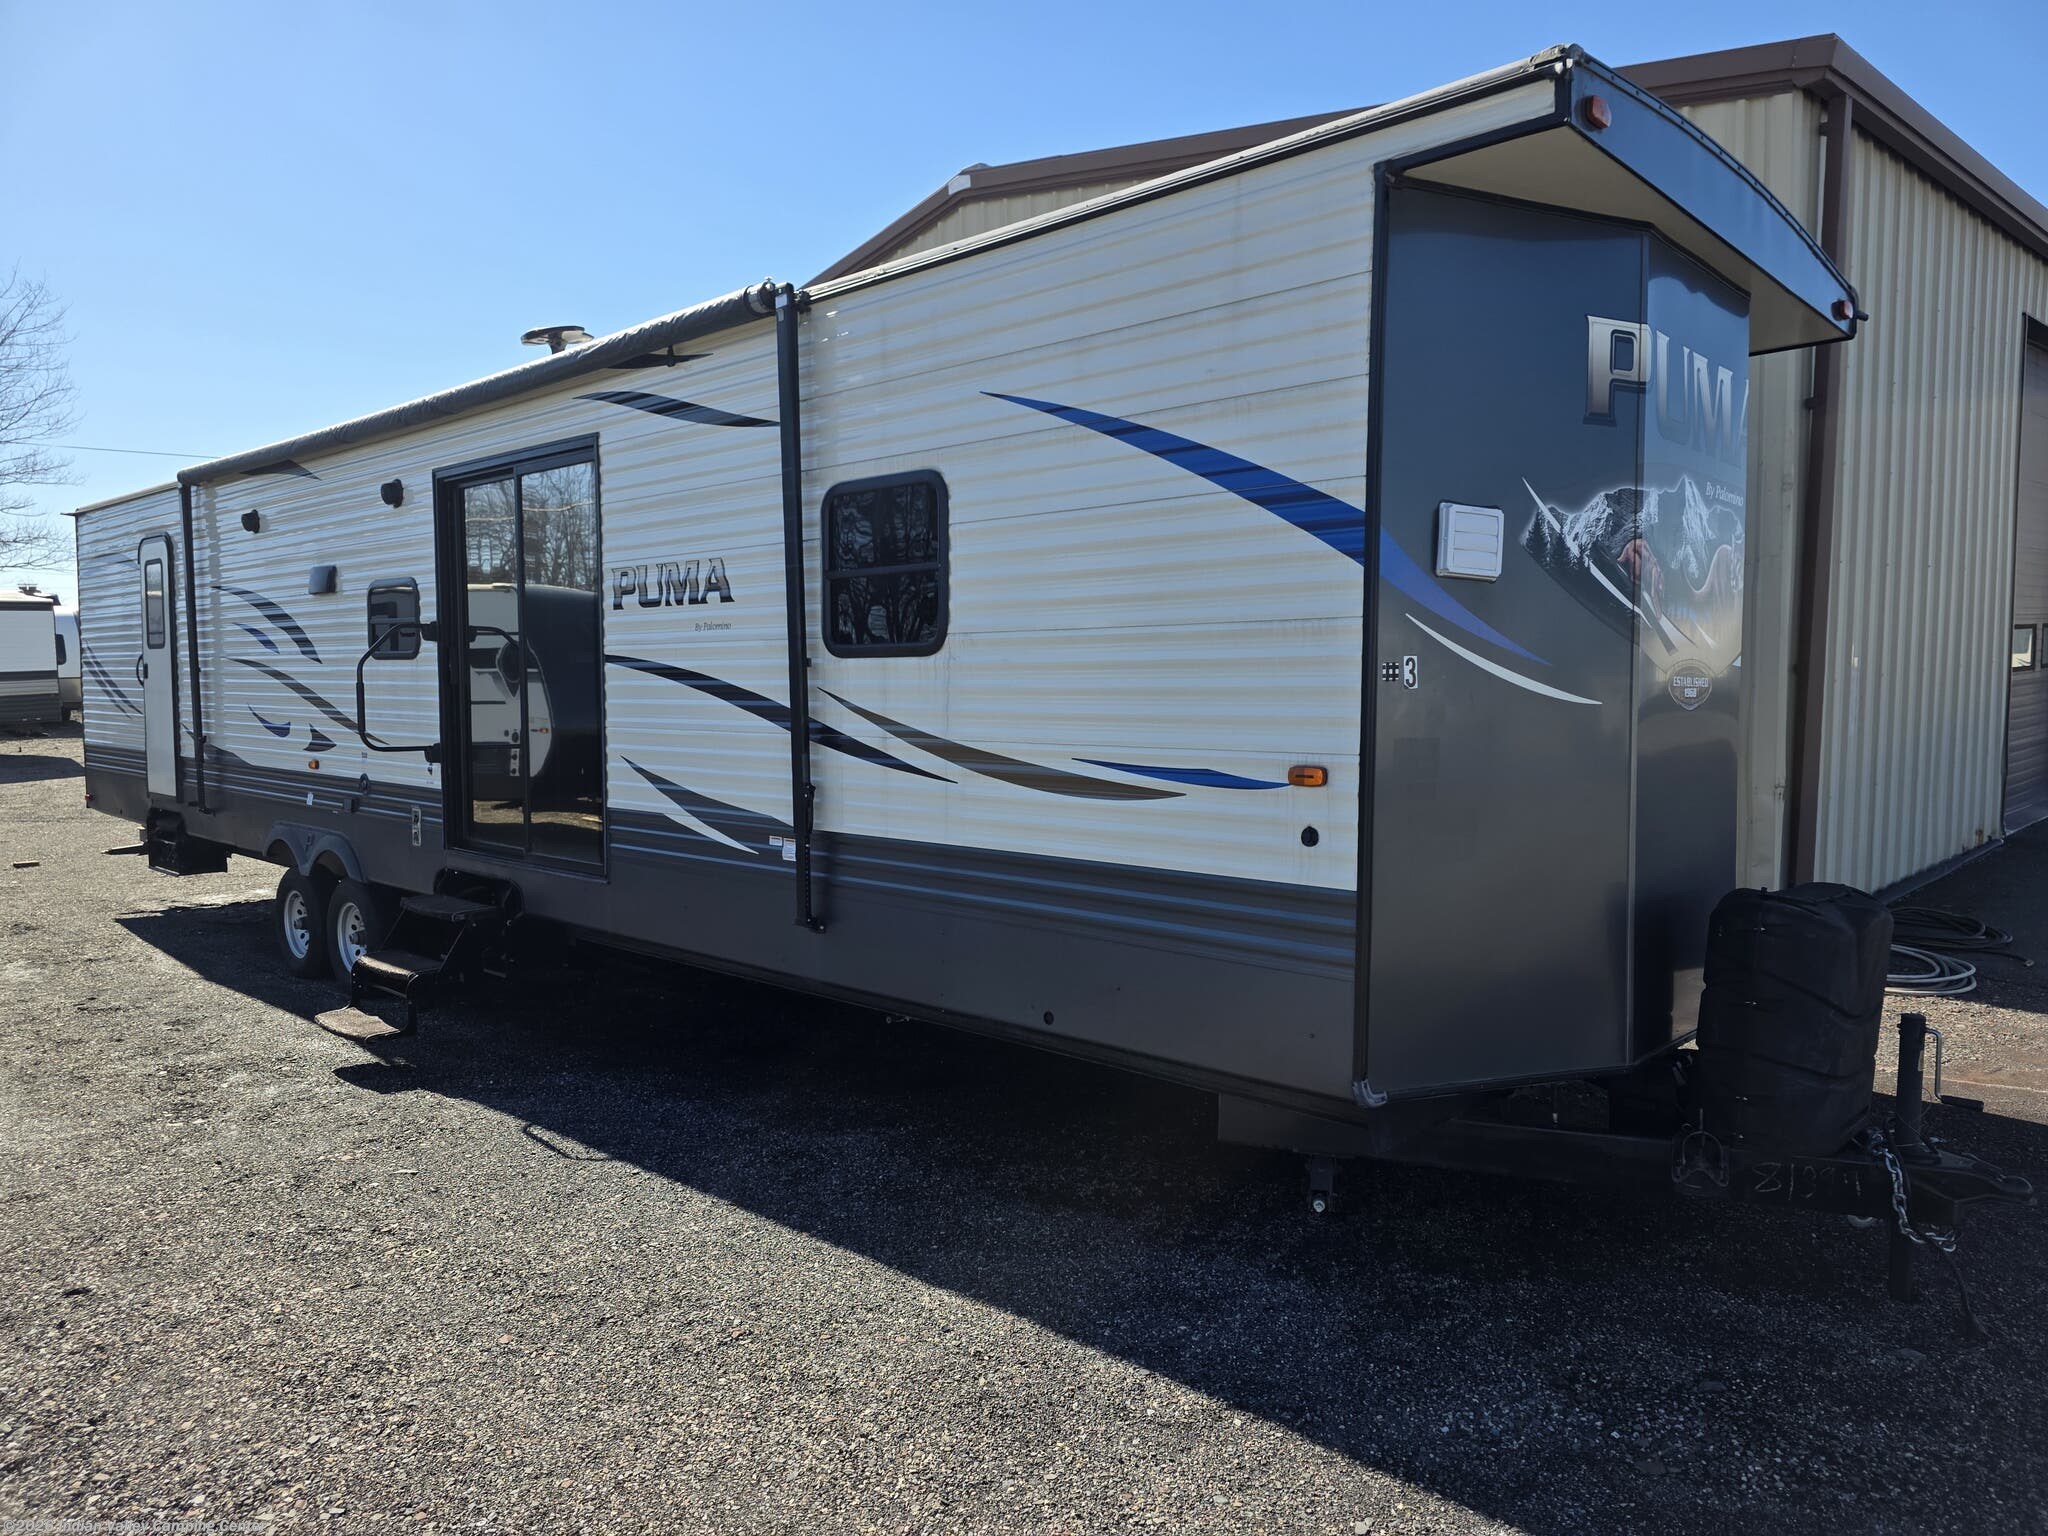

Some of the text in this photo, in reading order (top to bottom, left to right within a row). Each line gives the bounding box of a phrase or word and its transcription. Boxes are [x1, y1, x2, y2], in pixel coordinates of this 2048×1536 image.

[611, 557, 735, 610] PUMA
[694, 621, 732, 632] By Palomino
[1673, 676, 1709, 688] ESTABLISHED
